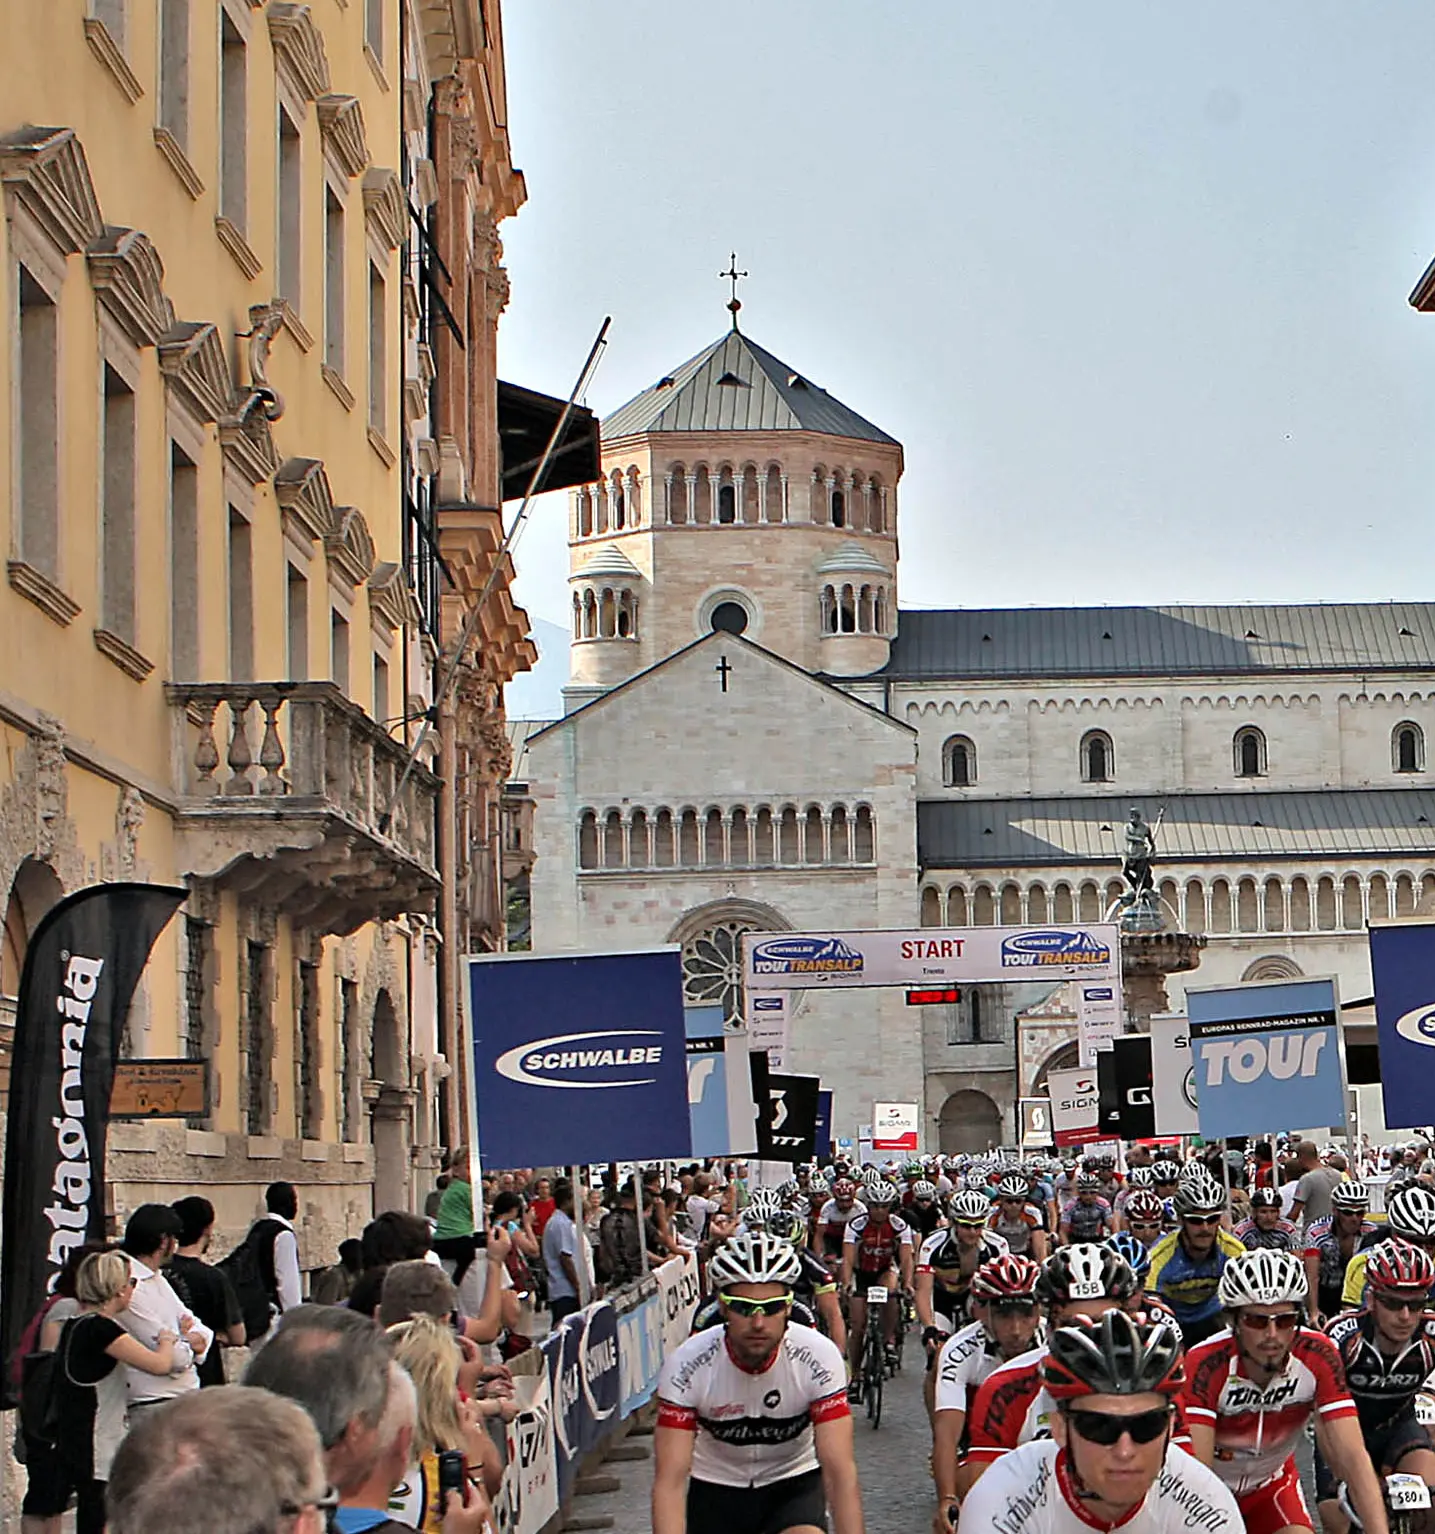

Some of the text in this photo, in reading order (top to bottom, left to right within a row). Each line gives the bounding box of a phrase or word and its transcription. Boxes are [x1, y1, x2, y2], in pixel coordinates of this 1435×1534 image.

[901, 940, 965, 959] START
[1038, 951, 1109, 964] TRANSALP
[790, 959, 862, 972] TRANSALP
[1201, 1023, 1235, 1034] EUROPAS
[525, 1047, 662, 1070] SCHWALBE
[44, 954, 105, 1300] atagonia
[1074, 1283, 1100, 1296] 15B
[1257, 1288, 1281, 1300] 15A
[1330, 1317, 1358, 1340] ZORZI
[1398, 1490, 1417, 1504] 580
